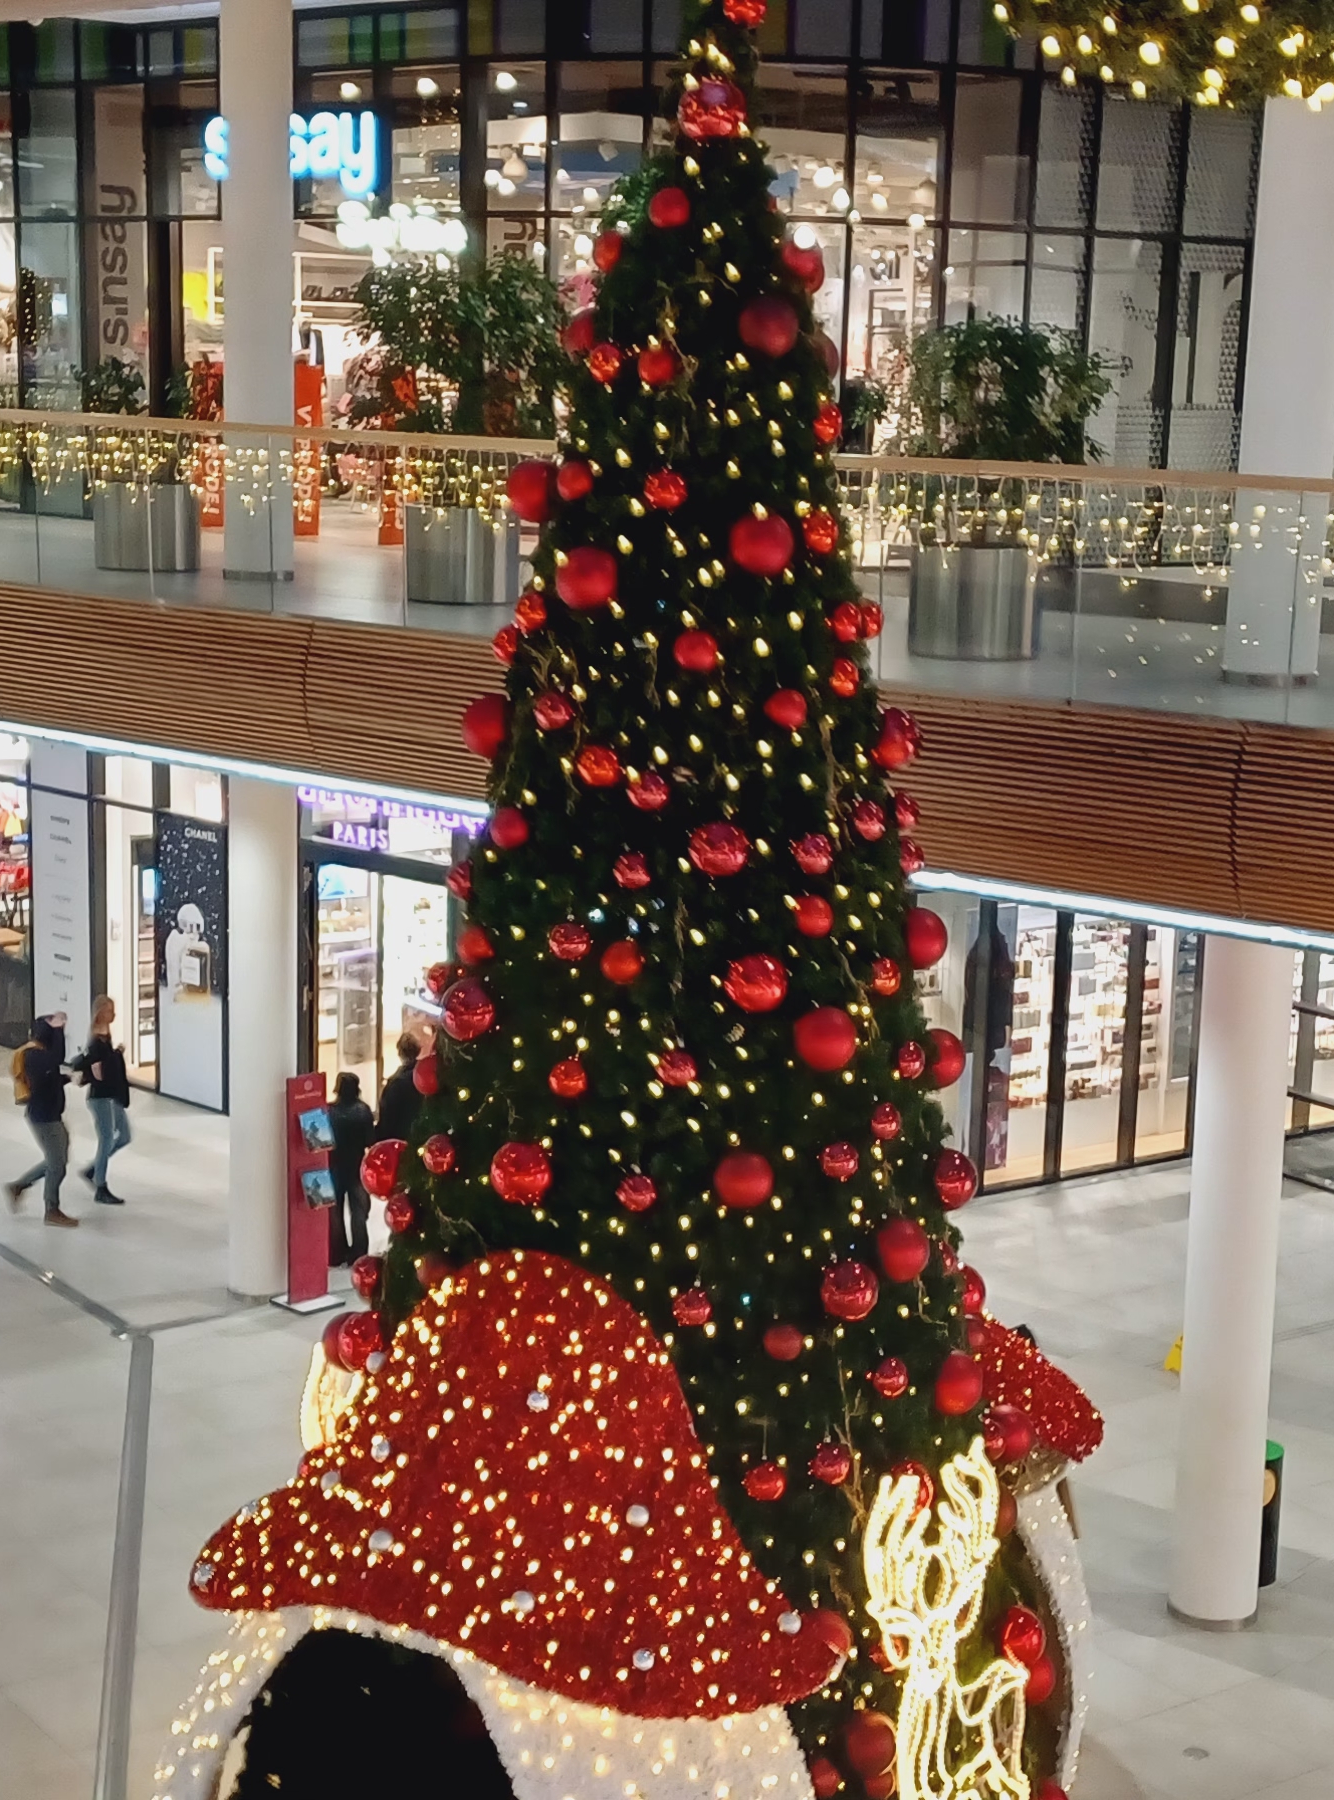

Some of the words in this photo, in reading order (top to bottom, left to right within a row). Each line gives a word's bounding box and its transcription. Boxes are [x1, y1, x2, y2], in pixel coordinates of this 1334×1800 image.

[99, 183, 138, 347] sinsay
[184, 826, 217, 843] CHANEL
[332, 820, 388, 849] PARIS
